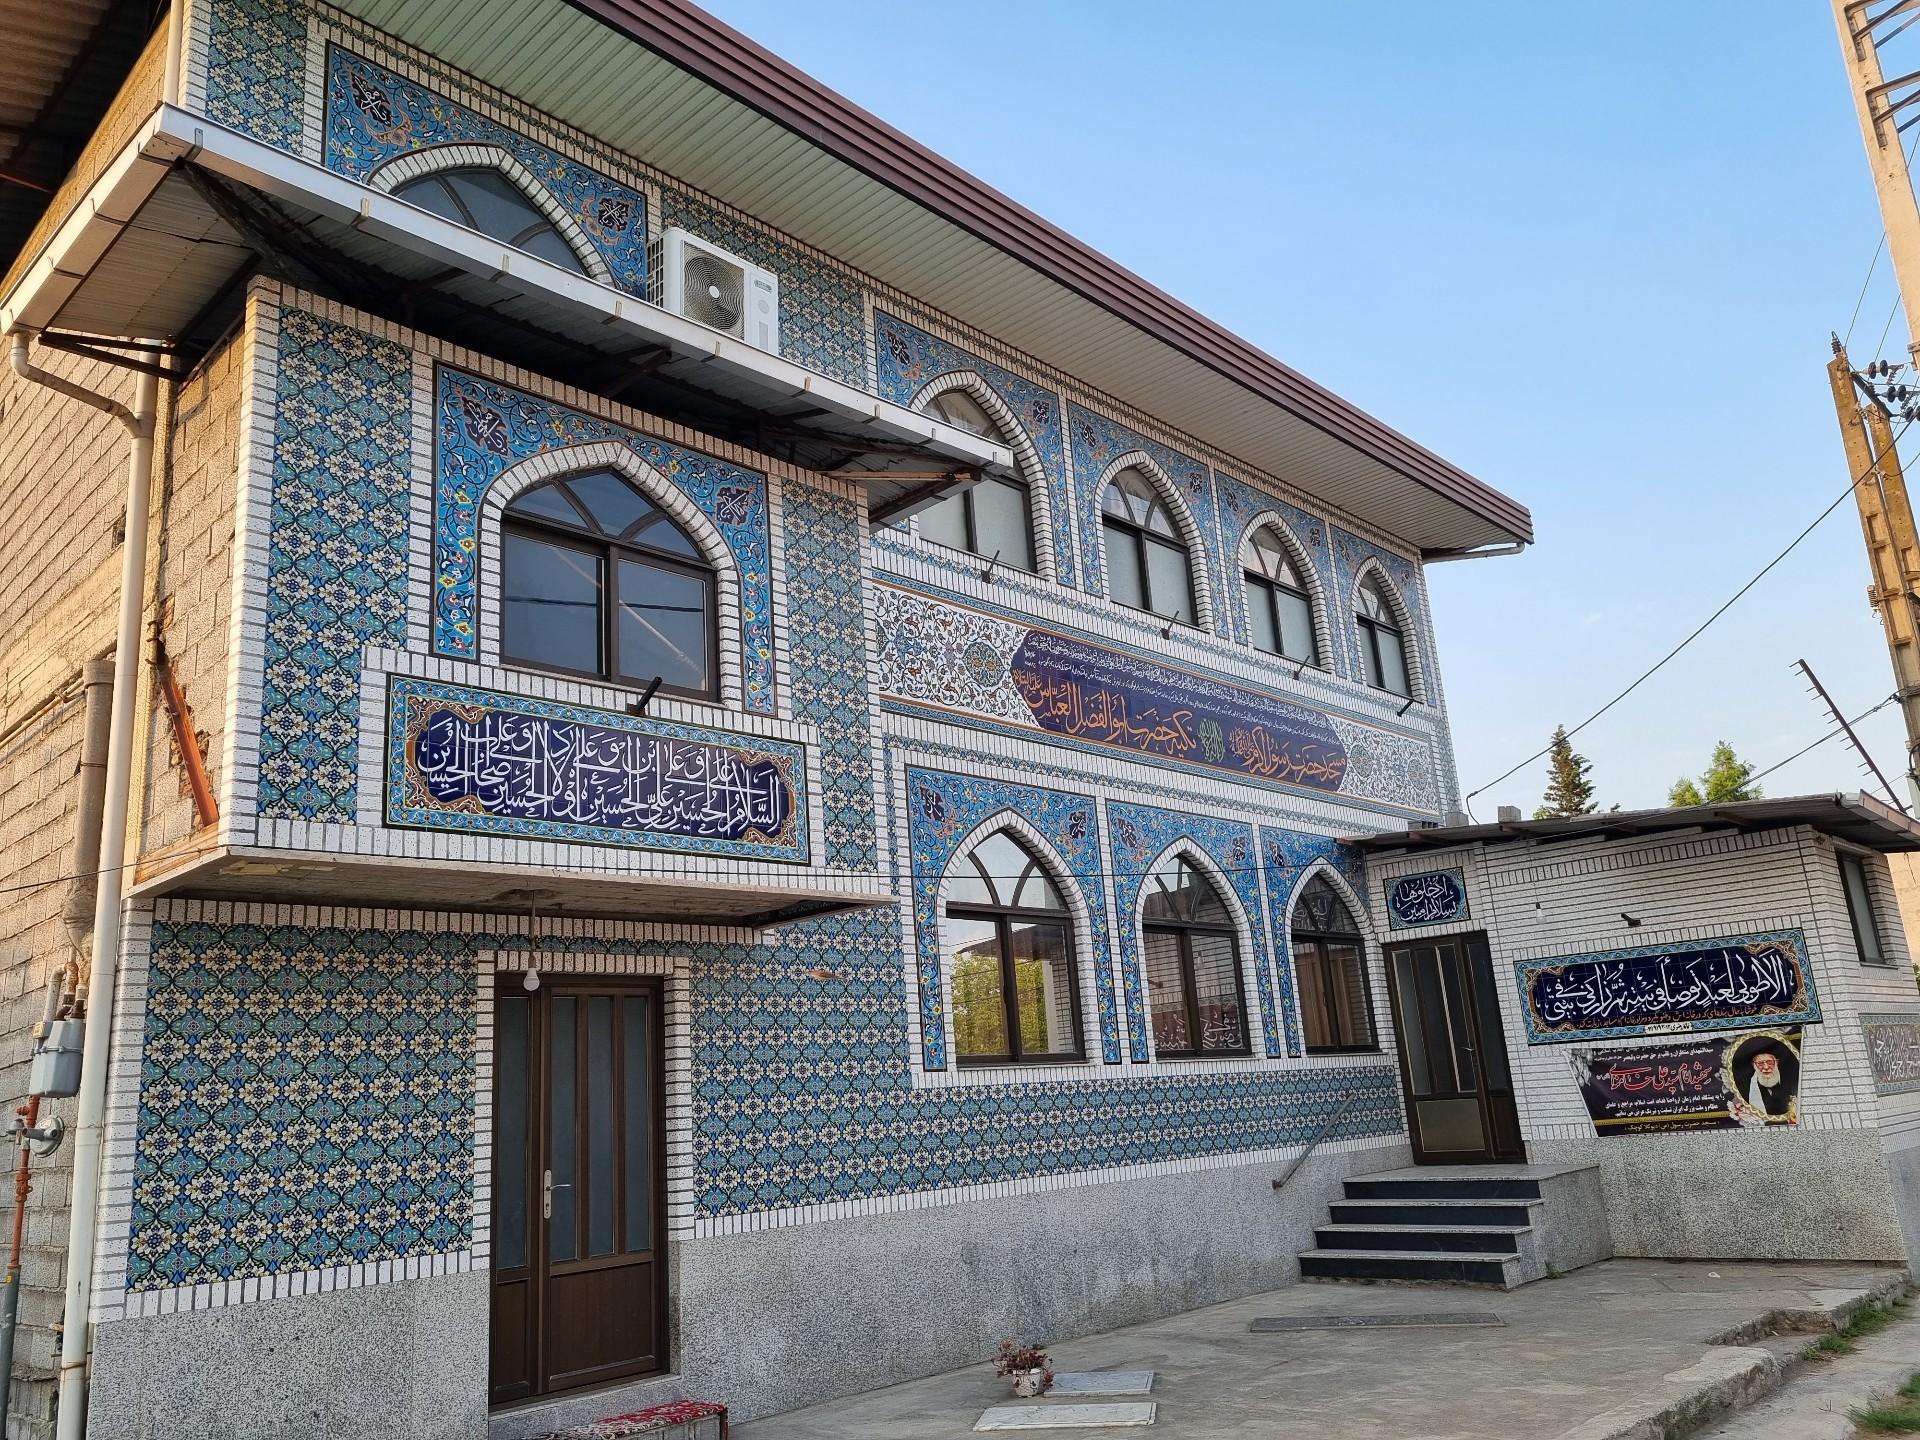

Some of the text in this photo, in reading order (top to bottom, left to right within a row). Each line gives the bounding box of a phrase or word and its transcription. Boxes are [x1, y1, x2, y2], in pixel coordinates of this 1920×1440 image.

[1024, 676, 1077, 723] العباس
[1066, 685, 1128, 743] ابوالفضل
[1126, 708, 1179, 750] حضرت
[1166, 710, 1197, 758] تکیه
[1294, 745, 1326, 783] حضرت
[1320, 752, 1346, 785] مسجد
[718, 761, 780, 833] السلام
[1399, 876, 1448, 903] ادخلوها
[1695, 950, 1735, 1006] لعبد
[1619, 985, 1655, 1014] بیته
[1653, 1066, 1668, 1090] علی
